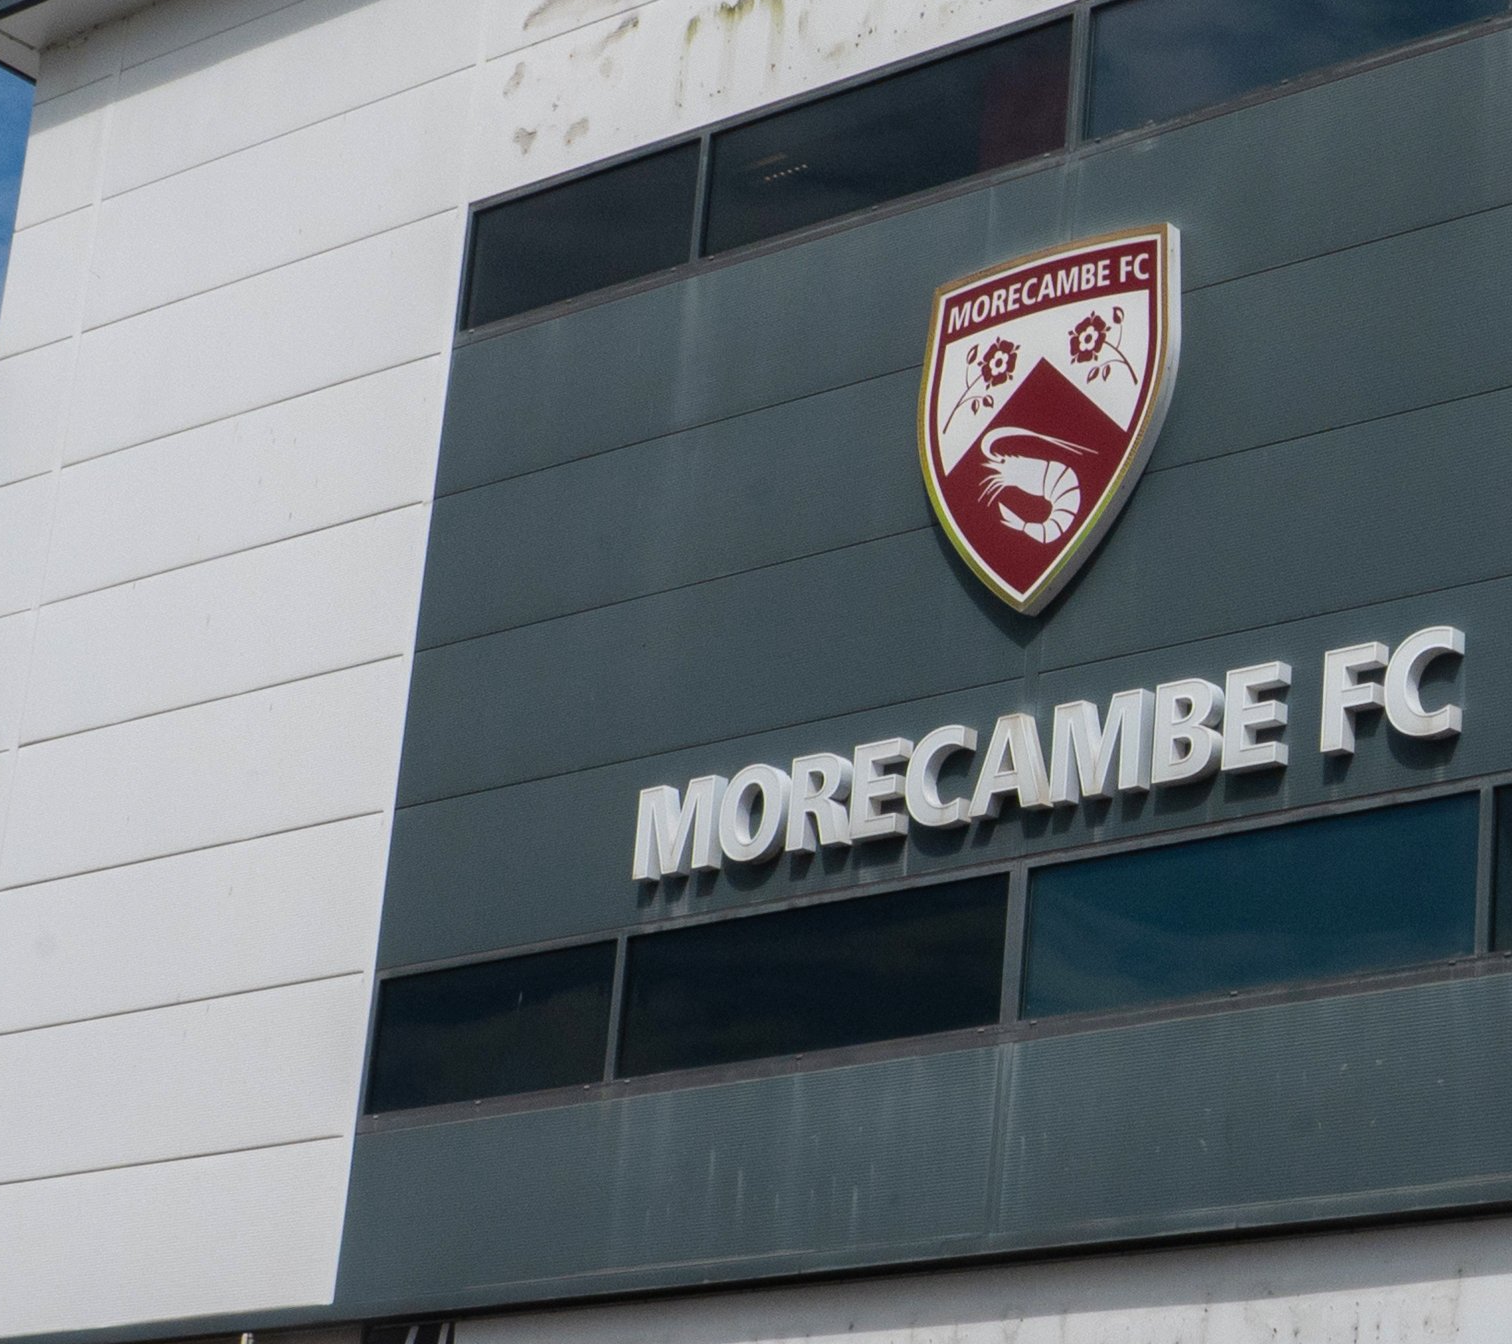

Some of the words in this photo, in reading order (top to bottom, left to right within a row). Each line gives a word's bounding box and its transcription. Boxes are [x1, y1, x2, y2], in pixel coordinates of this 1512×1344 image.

[947, 259, 1110, 334] MORECAMBE
[1120, 253, 1149, 283] FC
[631, 661, 1292, 883] MORECAMBE
[1320, 625, 1466, 757] FC
